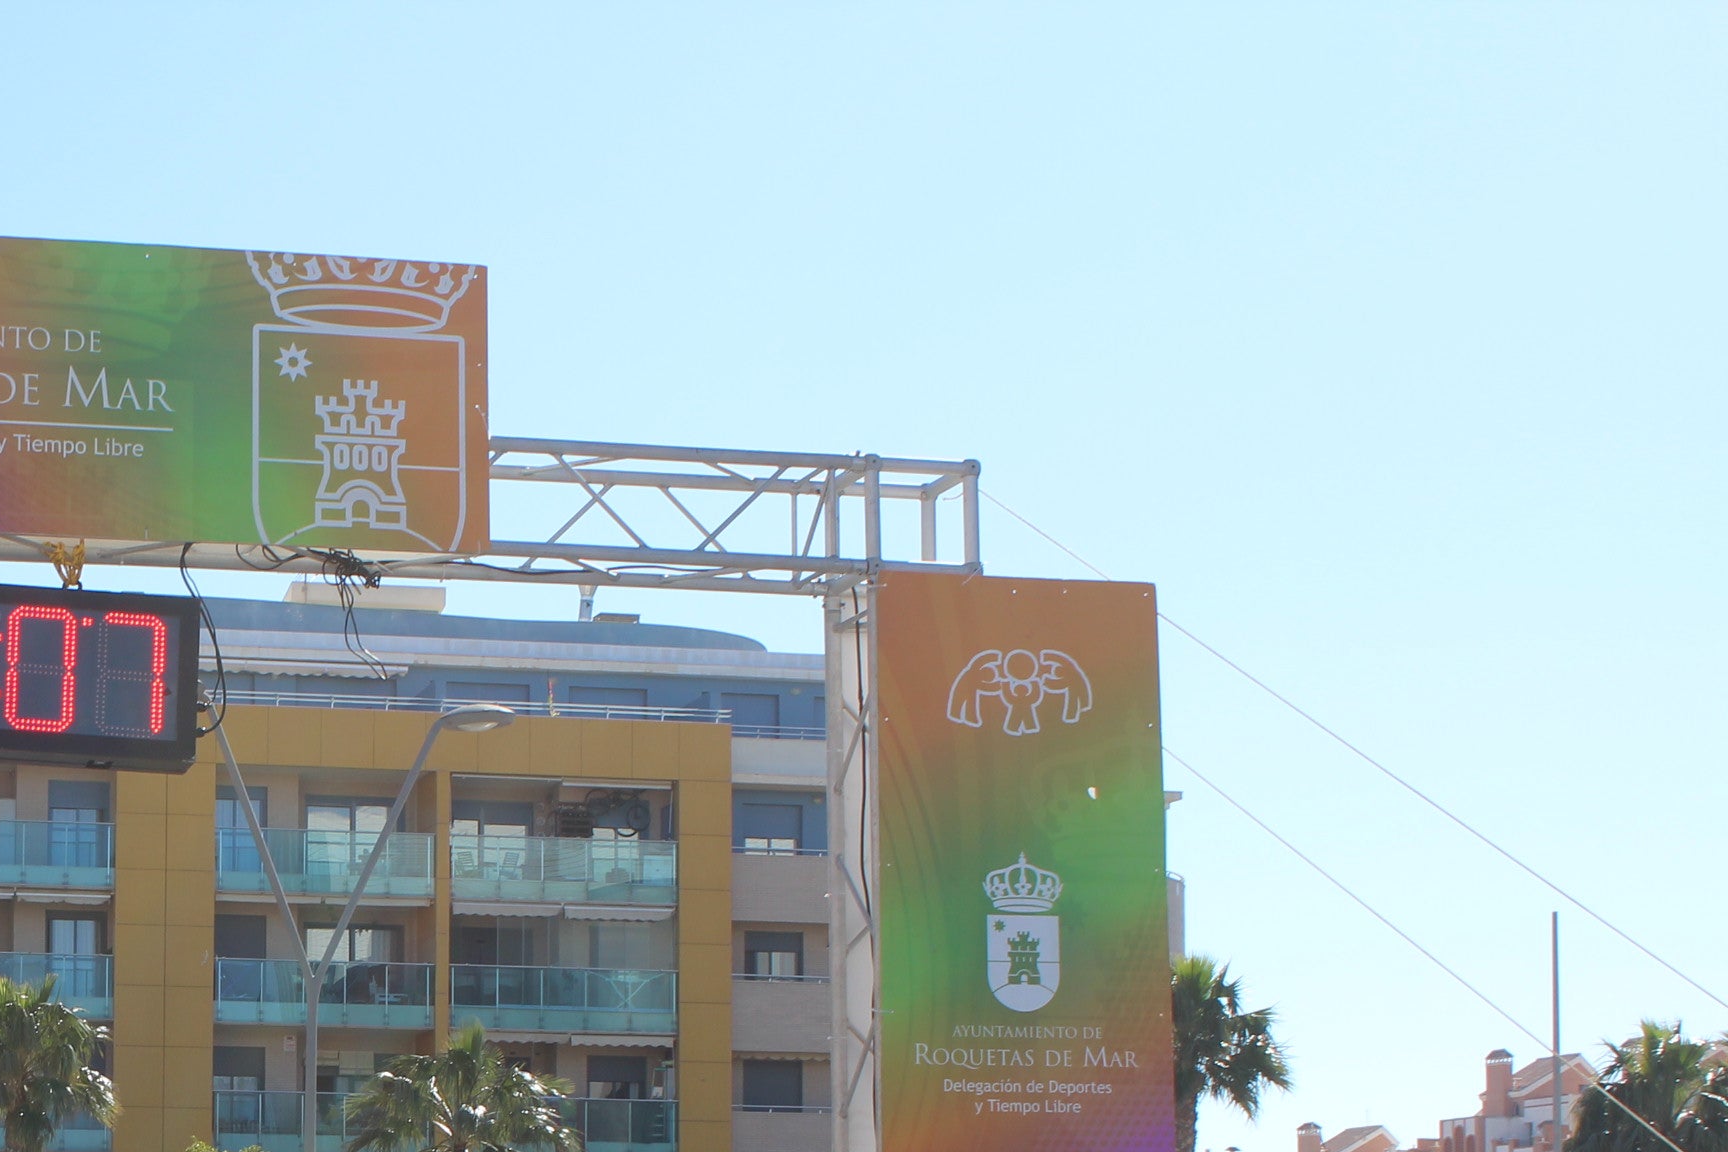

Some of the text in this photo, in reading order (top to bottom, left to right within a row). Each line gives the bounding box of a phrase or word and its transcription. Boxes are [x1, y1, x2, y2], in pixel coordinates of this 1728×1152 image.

[64, 327, 102, 353] DE
[62, 365, 175, 412] MAR
[13, 433, 87, 459] Tiempo
[94, 437, 145, 458] Libre
[952, 1024, 1103, 1039] AYUNTAMIENTO DE
[1045, 1049, 1072, 1067] DE
[943, 1078, 1113, 1096] Delegación de Deportes
[974, 1098, 1081, 1115] y Tiempo Libre
